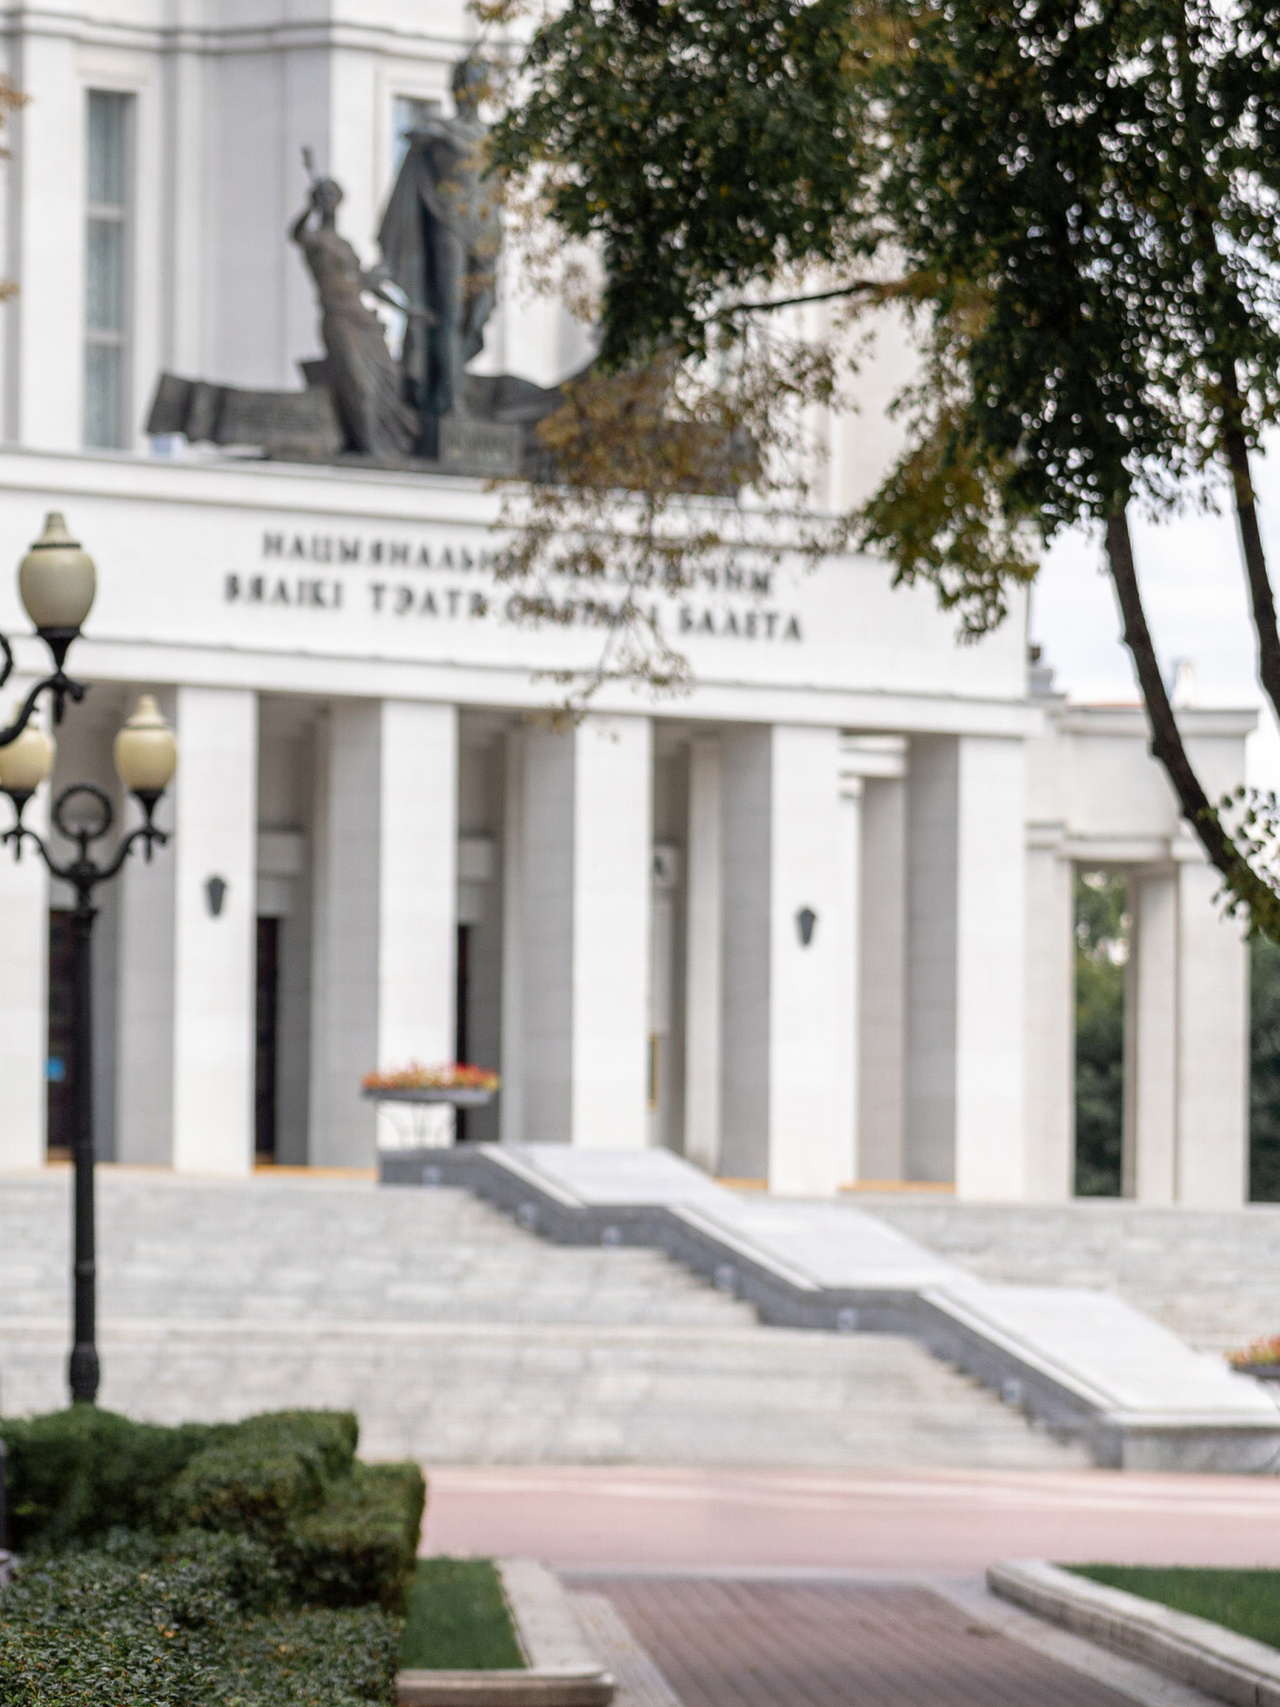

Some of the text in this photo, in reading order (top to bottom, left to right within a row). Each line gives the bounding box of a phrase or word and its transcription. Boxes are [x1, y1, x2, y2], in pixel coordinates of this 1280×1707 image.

[224, 574, 342, 609] ВЯЛІКІ
[370, 583, 488, 619] ТЭАТР
[678, 606, 803, 642] БАЛЕТА
